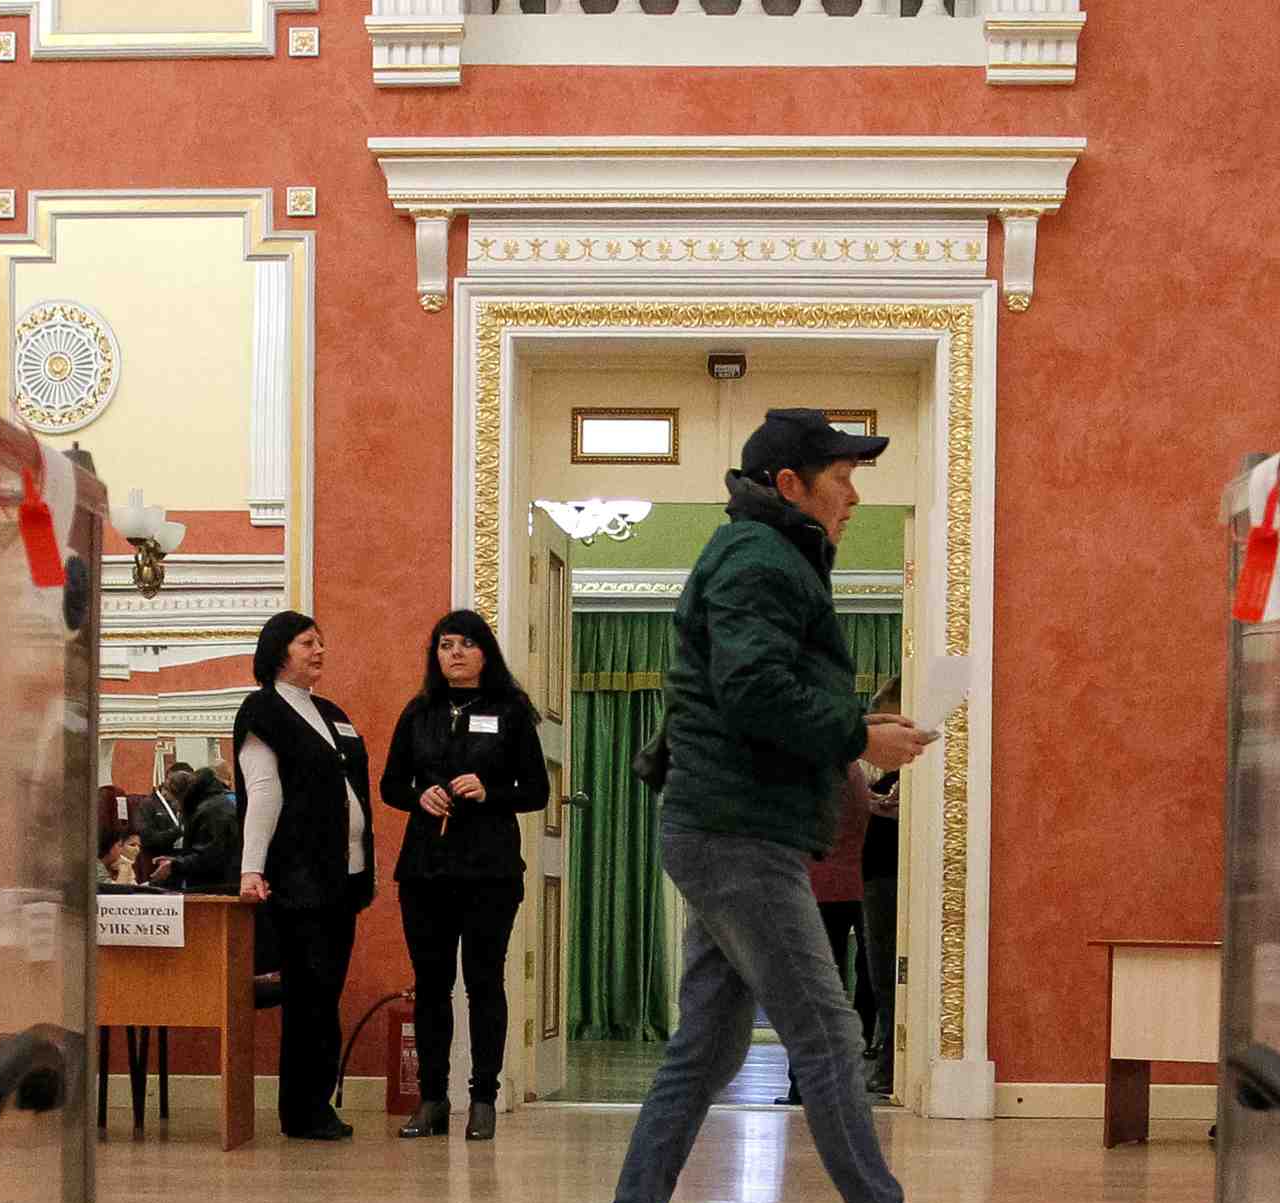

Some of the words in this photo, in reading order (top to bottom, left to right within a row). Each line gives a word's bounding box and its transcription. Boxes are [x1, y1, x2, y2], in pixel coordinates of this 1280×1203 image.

[96, 906, 179, 918] редседатель
[99, 923, 130, 935] УИК
[134, 923, 170, 935] №158
